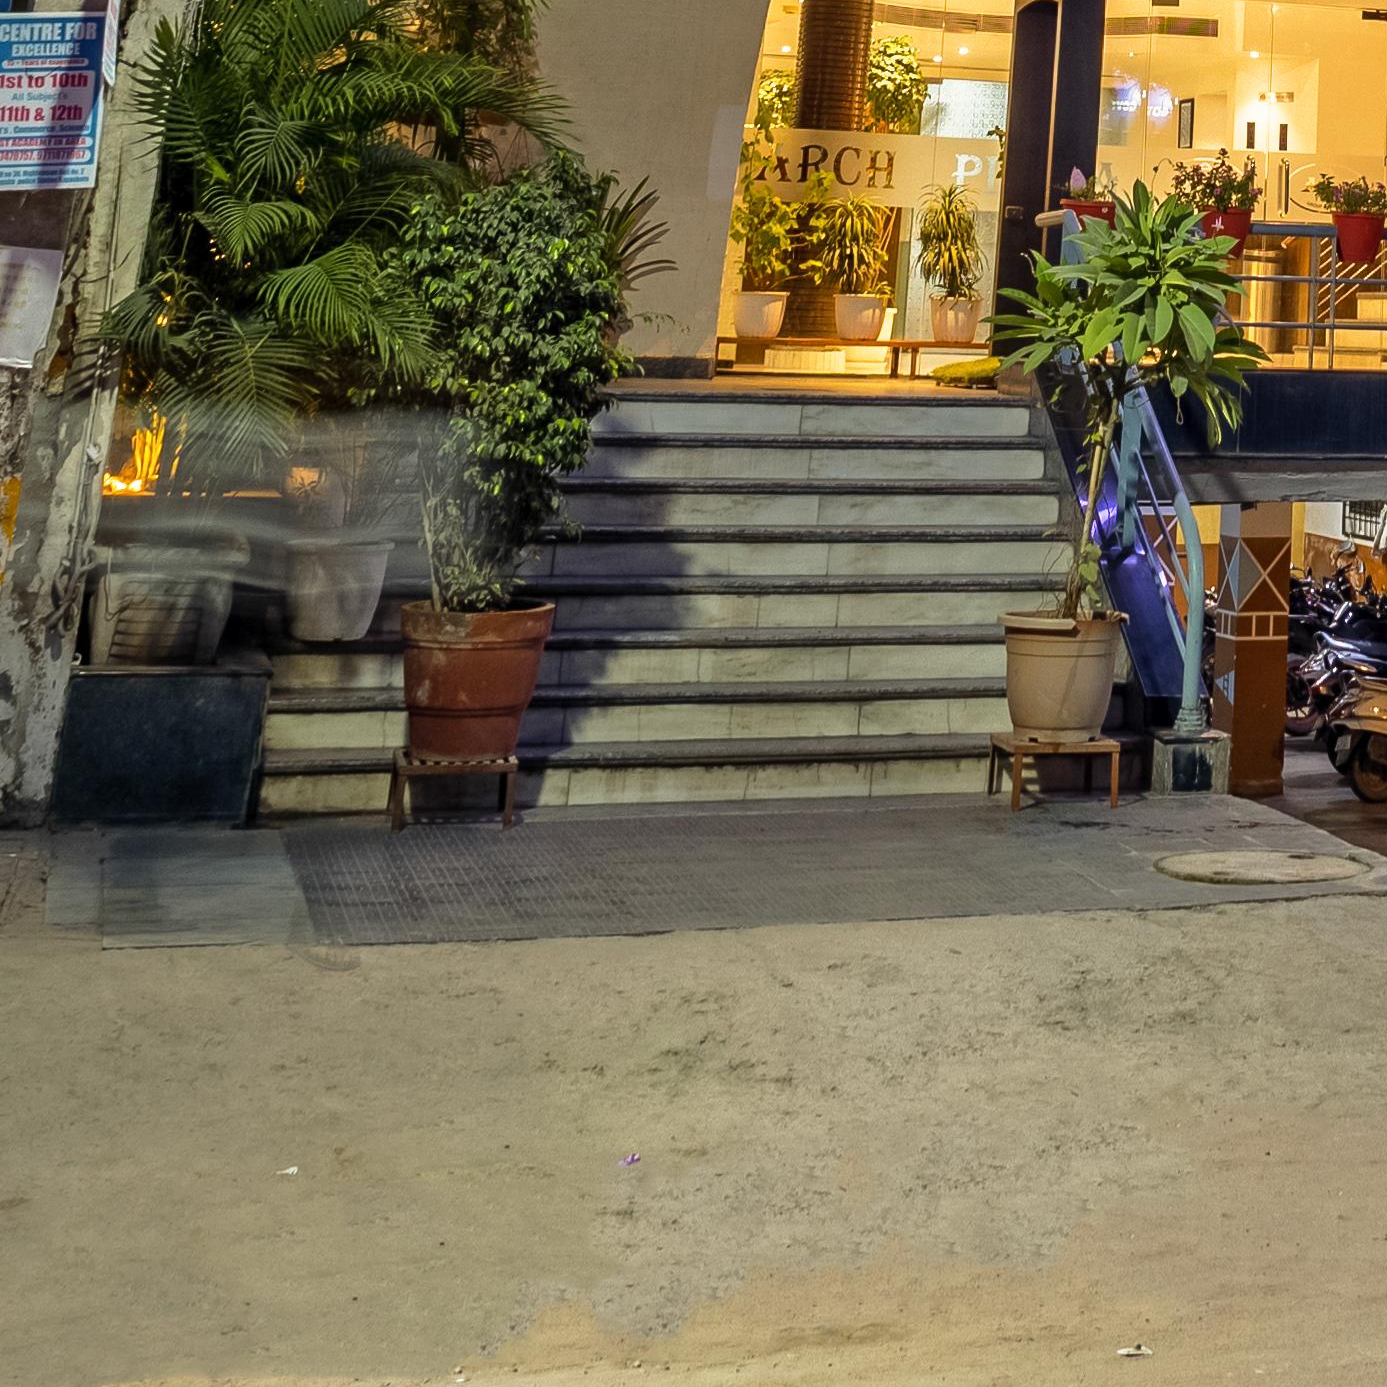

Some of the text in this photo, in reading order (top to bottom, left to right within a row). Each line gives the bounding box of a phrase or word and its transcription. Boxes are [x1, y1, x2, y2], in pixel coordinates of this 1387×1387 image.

[0, 21, 97, 42] CENTRE FOR
[12, 42, 80, 57] EXCELLENCE
[0, 72, 88, 89] 1st to 10th
[11, 93, 24, 101] All
[0, 105, 82, 122] 11th & 12th
[754, 144, 896, 190] ARCH
